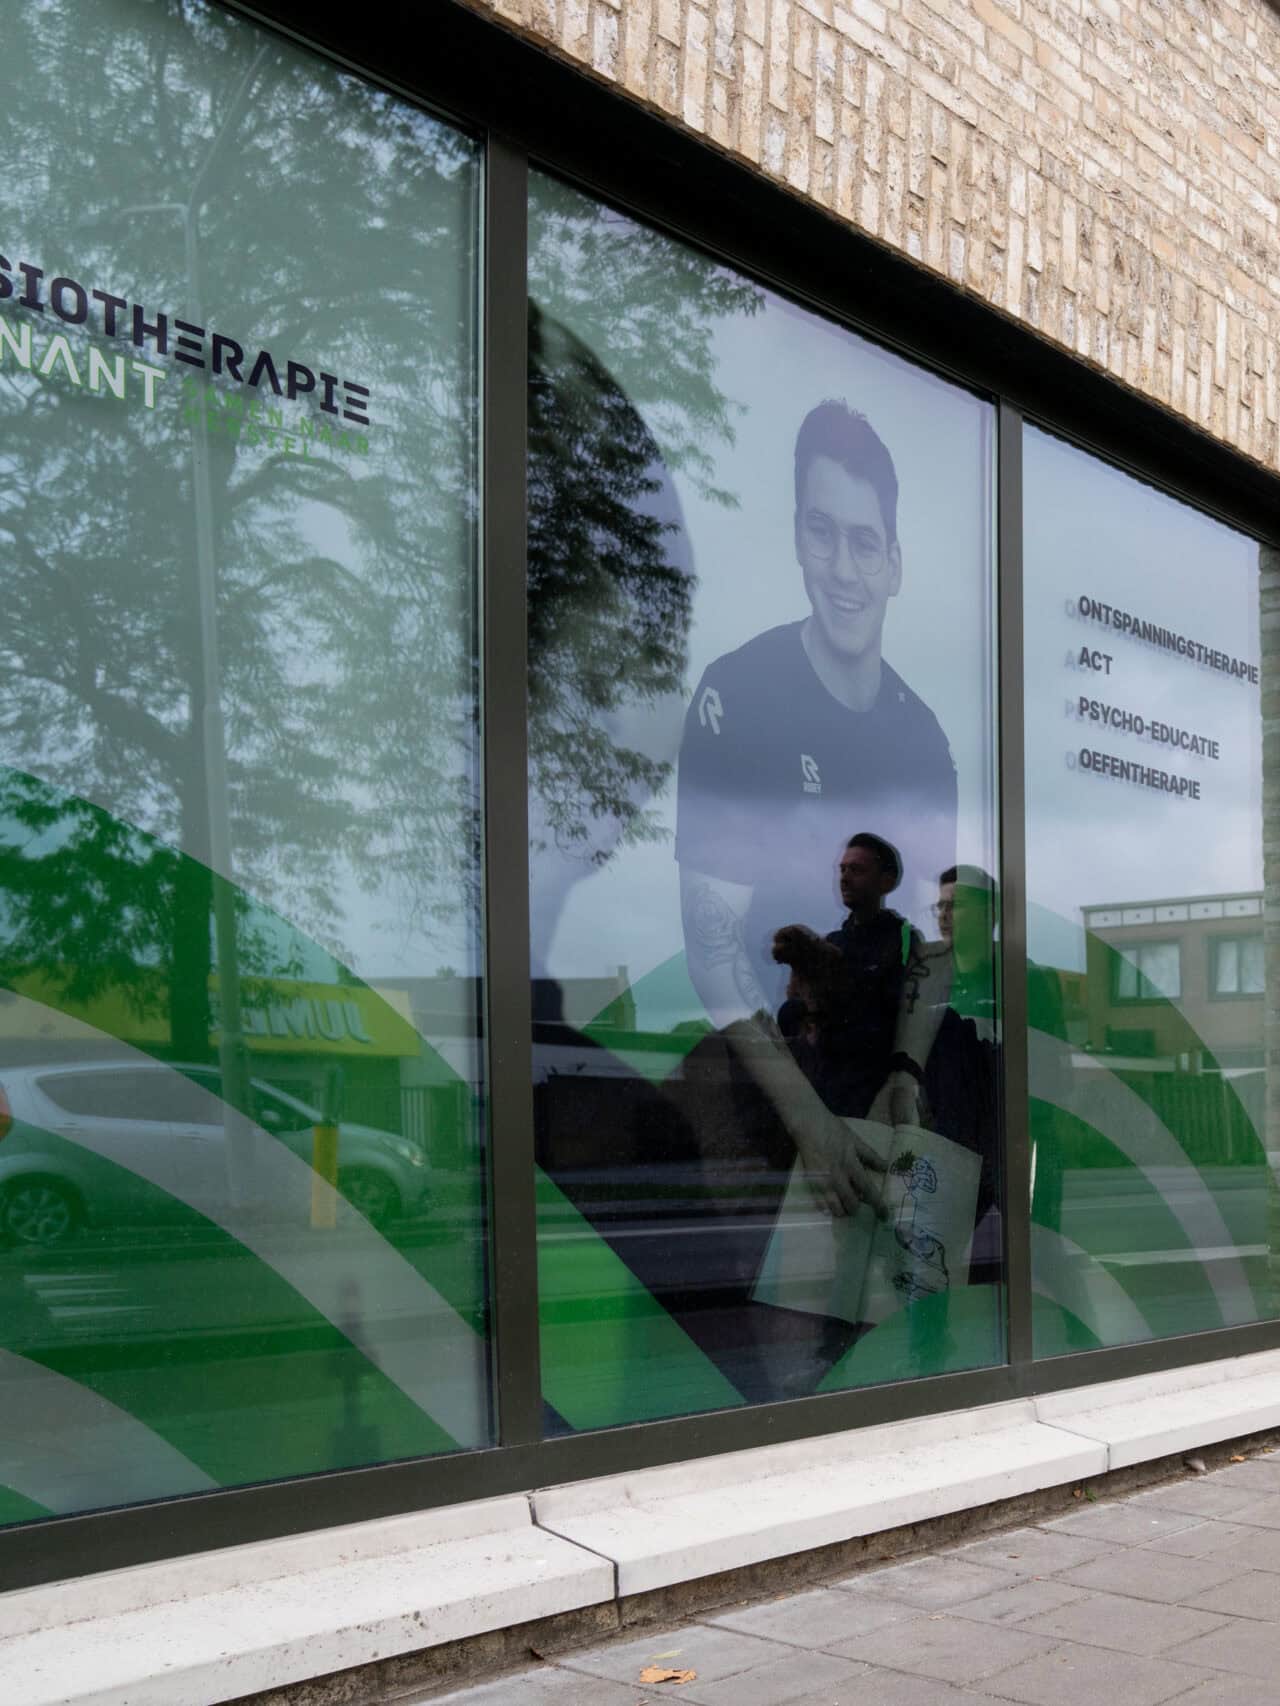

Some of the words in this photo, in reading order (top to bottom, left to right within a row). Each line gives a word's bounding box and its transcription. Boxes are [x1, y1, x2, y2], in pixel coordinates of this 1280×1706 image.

[182, 374, 284, 428] SAMEN
[300, 415, 370, 457] NAAR
[1078, 595, 1259, 685] ONTSPANNINGSTHERAPIE
[1078, 646, 1113, 675] ACT
[1078, 696, 1220, 761] PSYCHO-EDUCATIE
[1078, 748, 1201, 801] OEFENTHERAPIE
